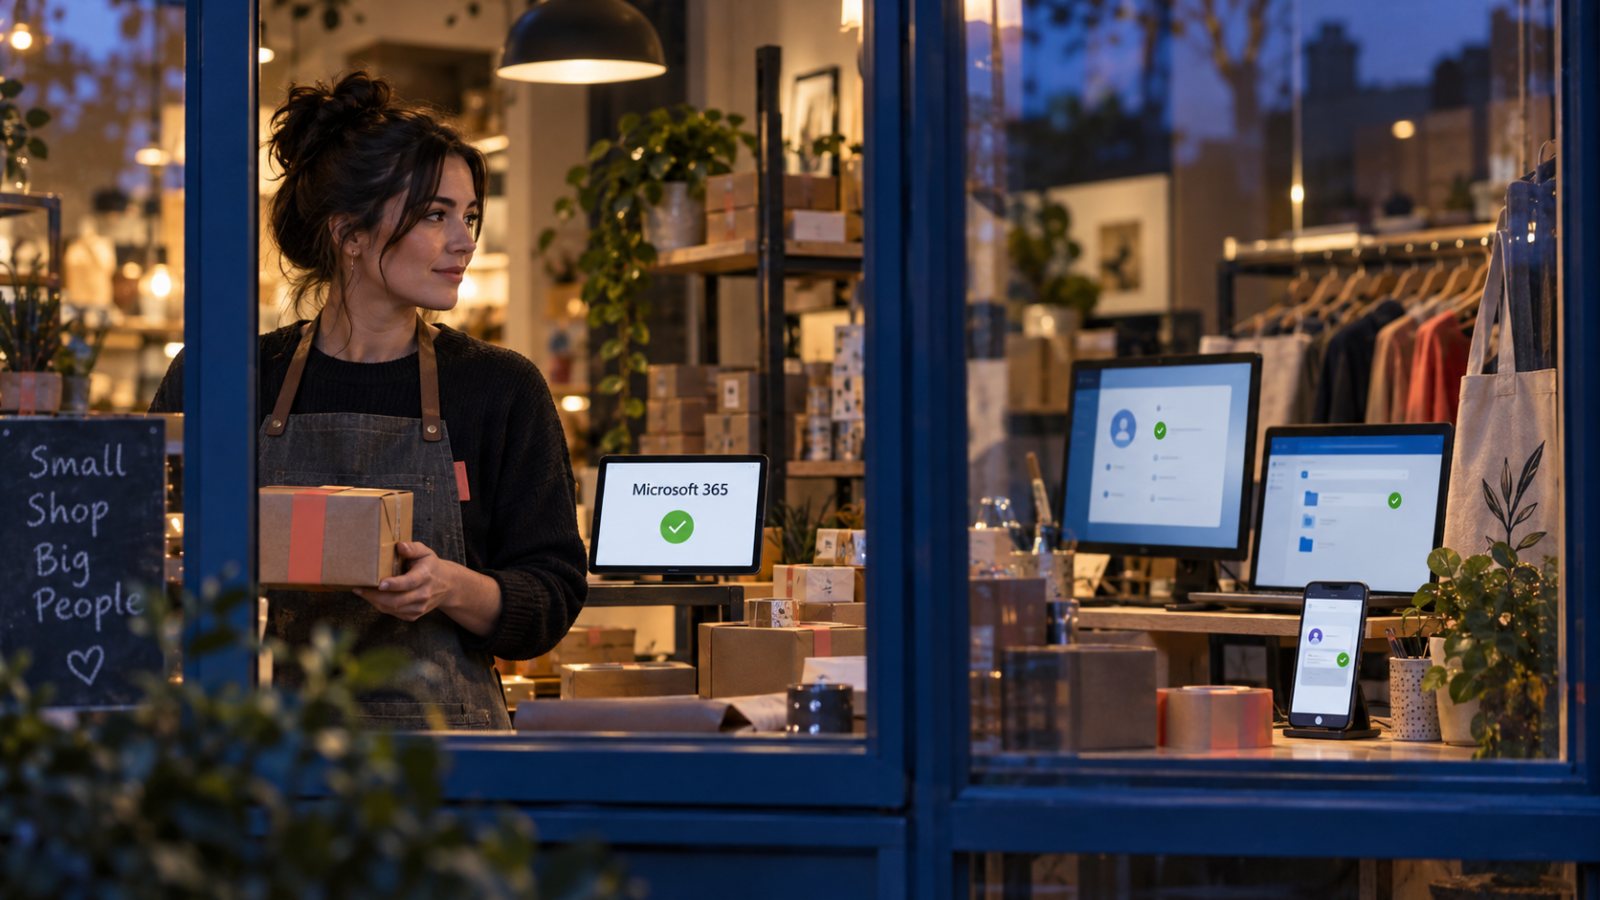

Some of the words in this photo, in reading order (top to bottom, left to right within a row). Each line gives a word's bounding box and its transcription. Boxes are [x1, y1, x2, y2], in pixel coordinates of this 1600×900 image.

[29, 443, 127, 479] Small
[632, 482, 699, 496] Microsoft
[702, 483, 729, 496] 365
[26, 491, 110, 538] Shop
[34, 541, 90, 588] Big
[32, 581, 145, 632] People
